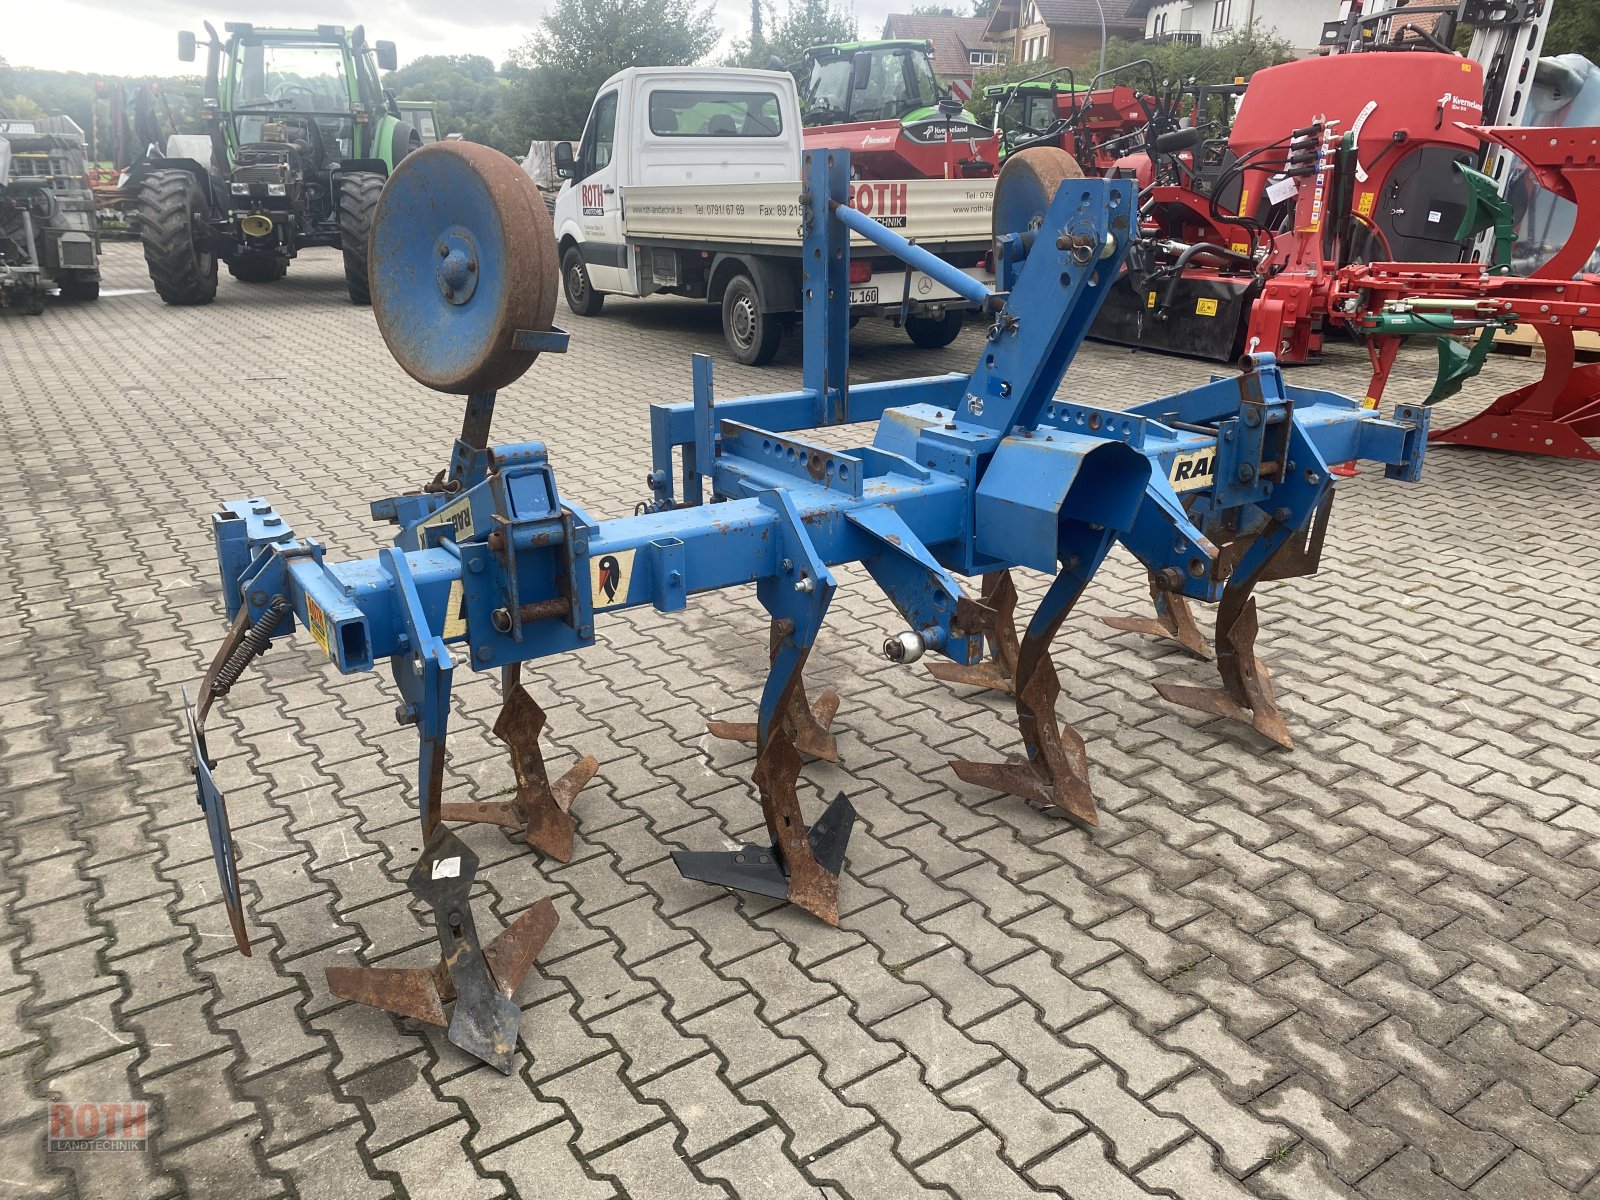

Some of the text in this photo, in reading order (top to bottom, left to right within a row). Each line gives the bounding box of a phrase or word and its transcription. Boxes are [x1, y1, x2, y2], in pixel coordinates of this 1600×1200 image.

[582, 184, 604, 207] ROTH
[726, 205, 734, 215] 67
[736, 205, 745, 215] 69
[759, 205, 775, 216] Fax:
[777, 205, 787, 216] 89
[859, 290, 877, 303] 160
